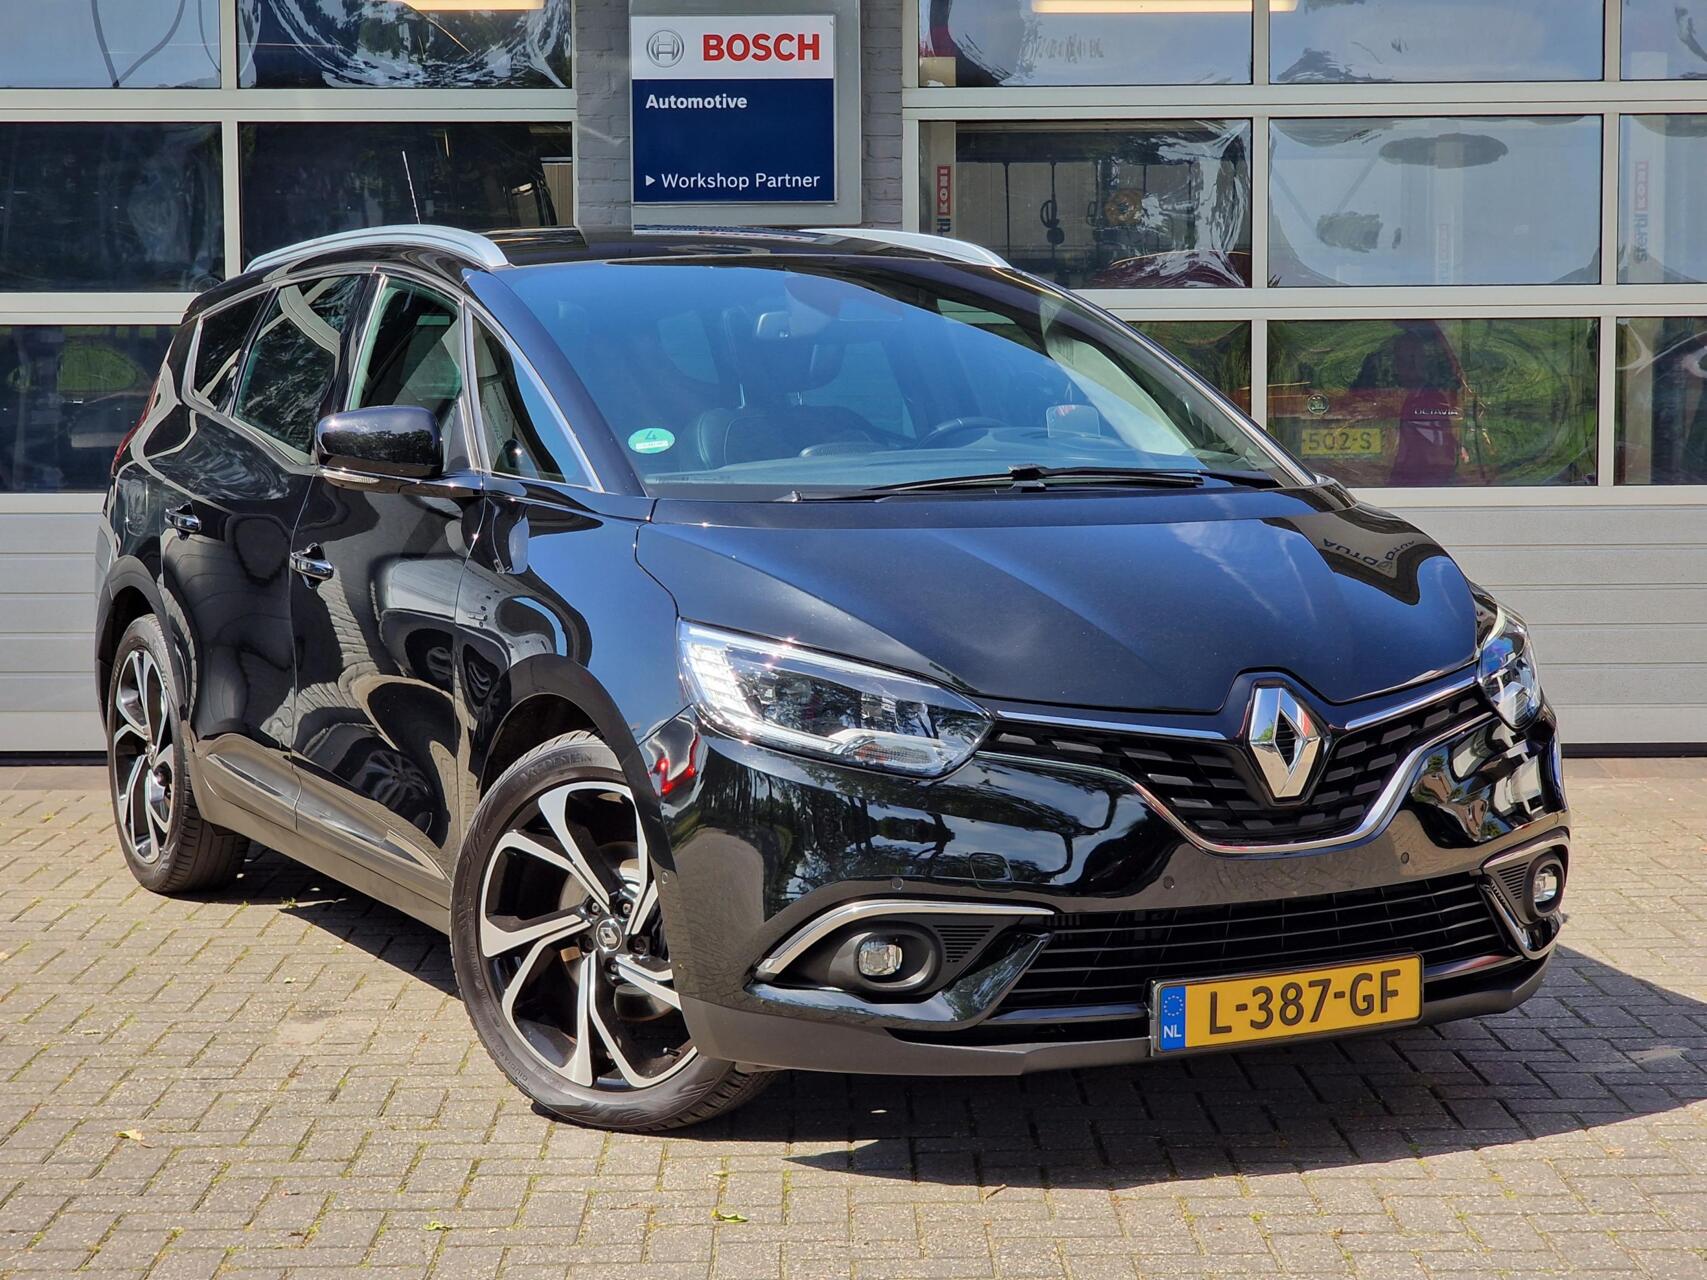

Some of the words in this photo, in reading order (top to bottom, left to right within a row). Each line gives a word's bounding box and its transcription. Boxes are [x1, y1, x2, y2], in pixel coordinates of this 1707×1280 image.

[703, 33, 820, 62] BOSCH
[645, 93, 748, 109] Automotive
[661, 173, 750, 191] Workshop
[755, 173, 820, 188] Partner
[1209, 968, 1401, 1035] L-387-GF
[1163, 1024, 1182, 1039] NL
